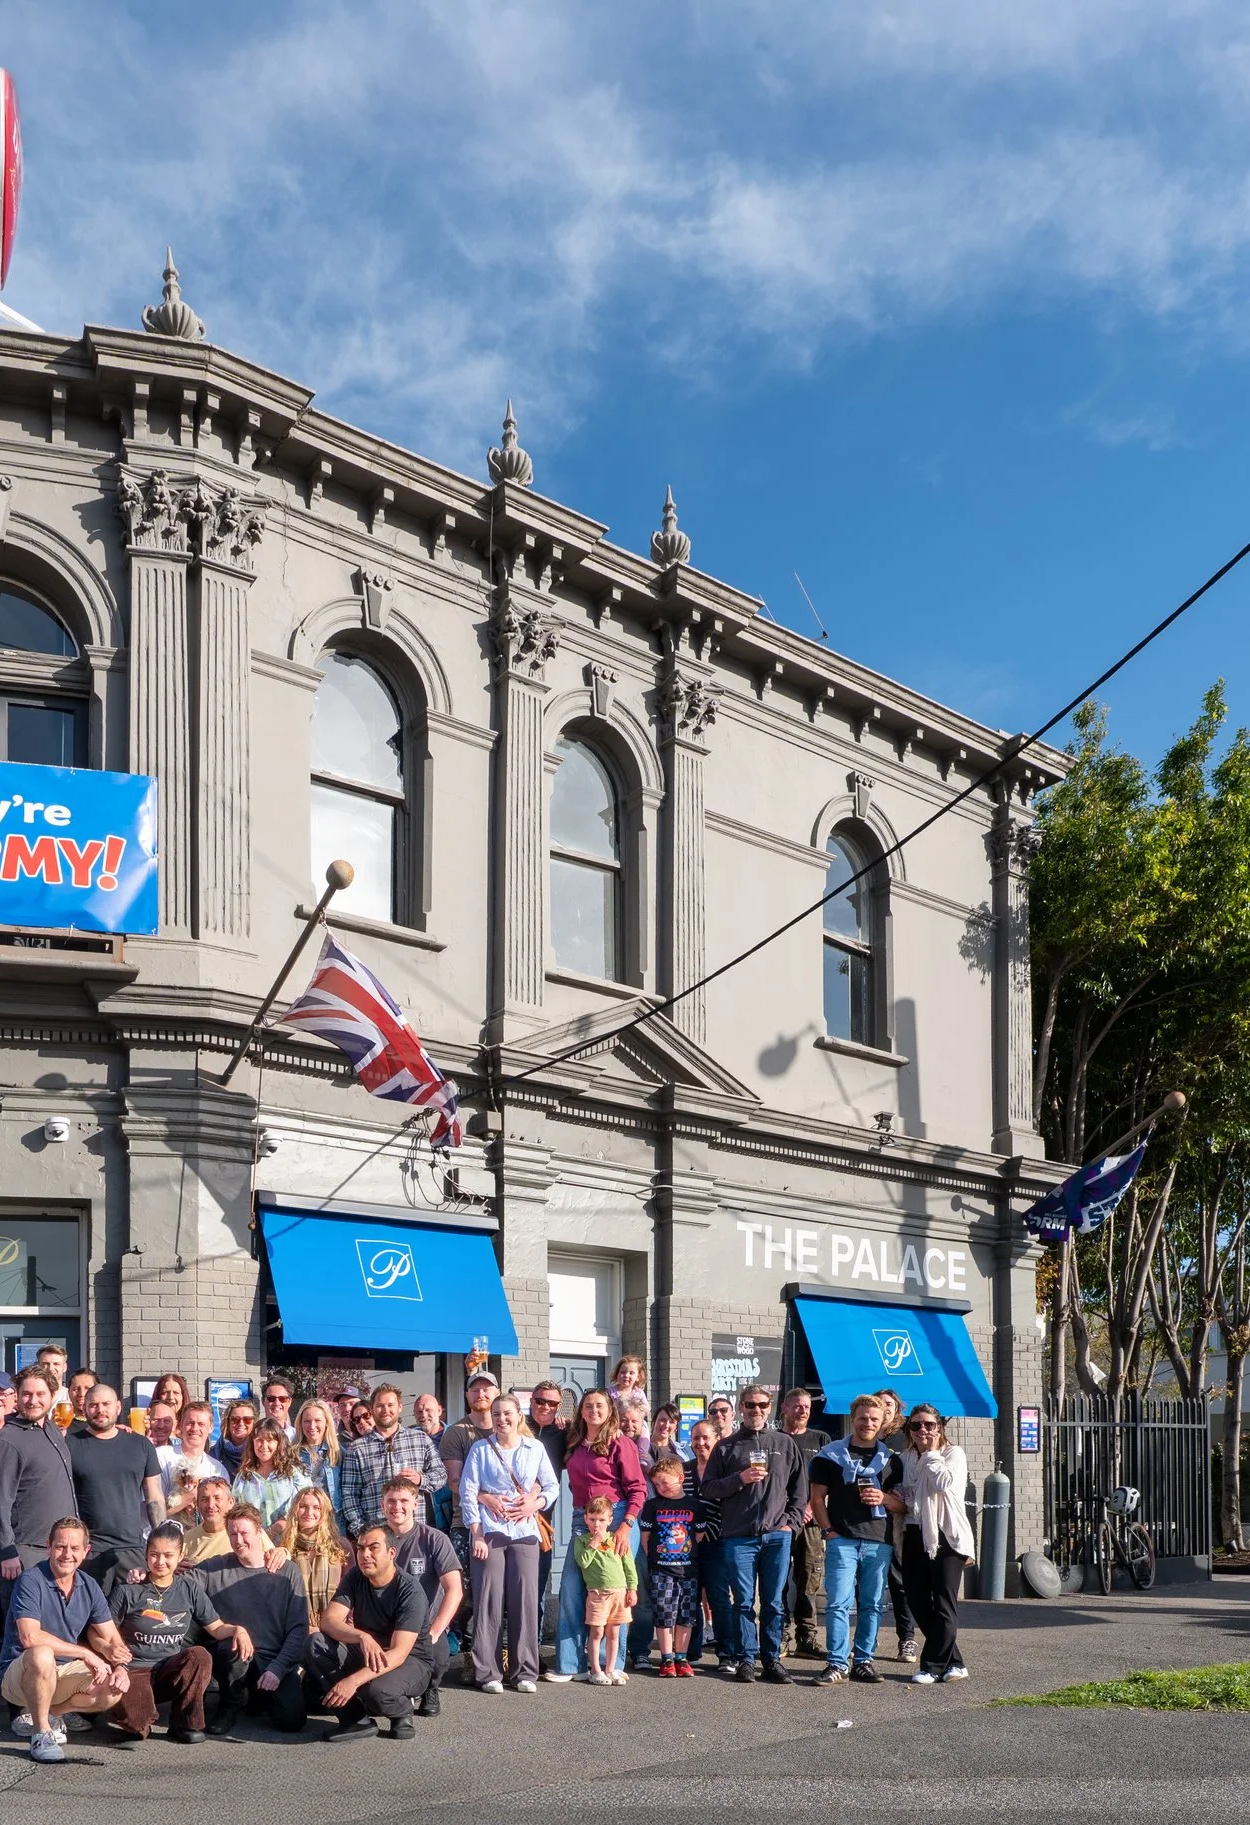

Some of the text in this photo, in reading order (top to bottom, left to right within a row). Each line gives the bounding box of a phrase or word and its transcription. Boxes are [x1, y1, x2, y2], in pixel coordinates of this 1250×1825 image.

[367, 1249, 410, 1289] P
[737, 1221, 967, 1291] THE PALACE
[736, 1346, 754, 1354] WOOD
[884, 1336, 911, 1368] P
[656, 1509, 694, 1522] MARIO
